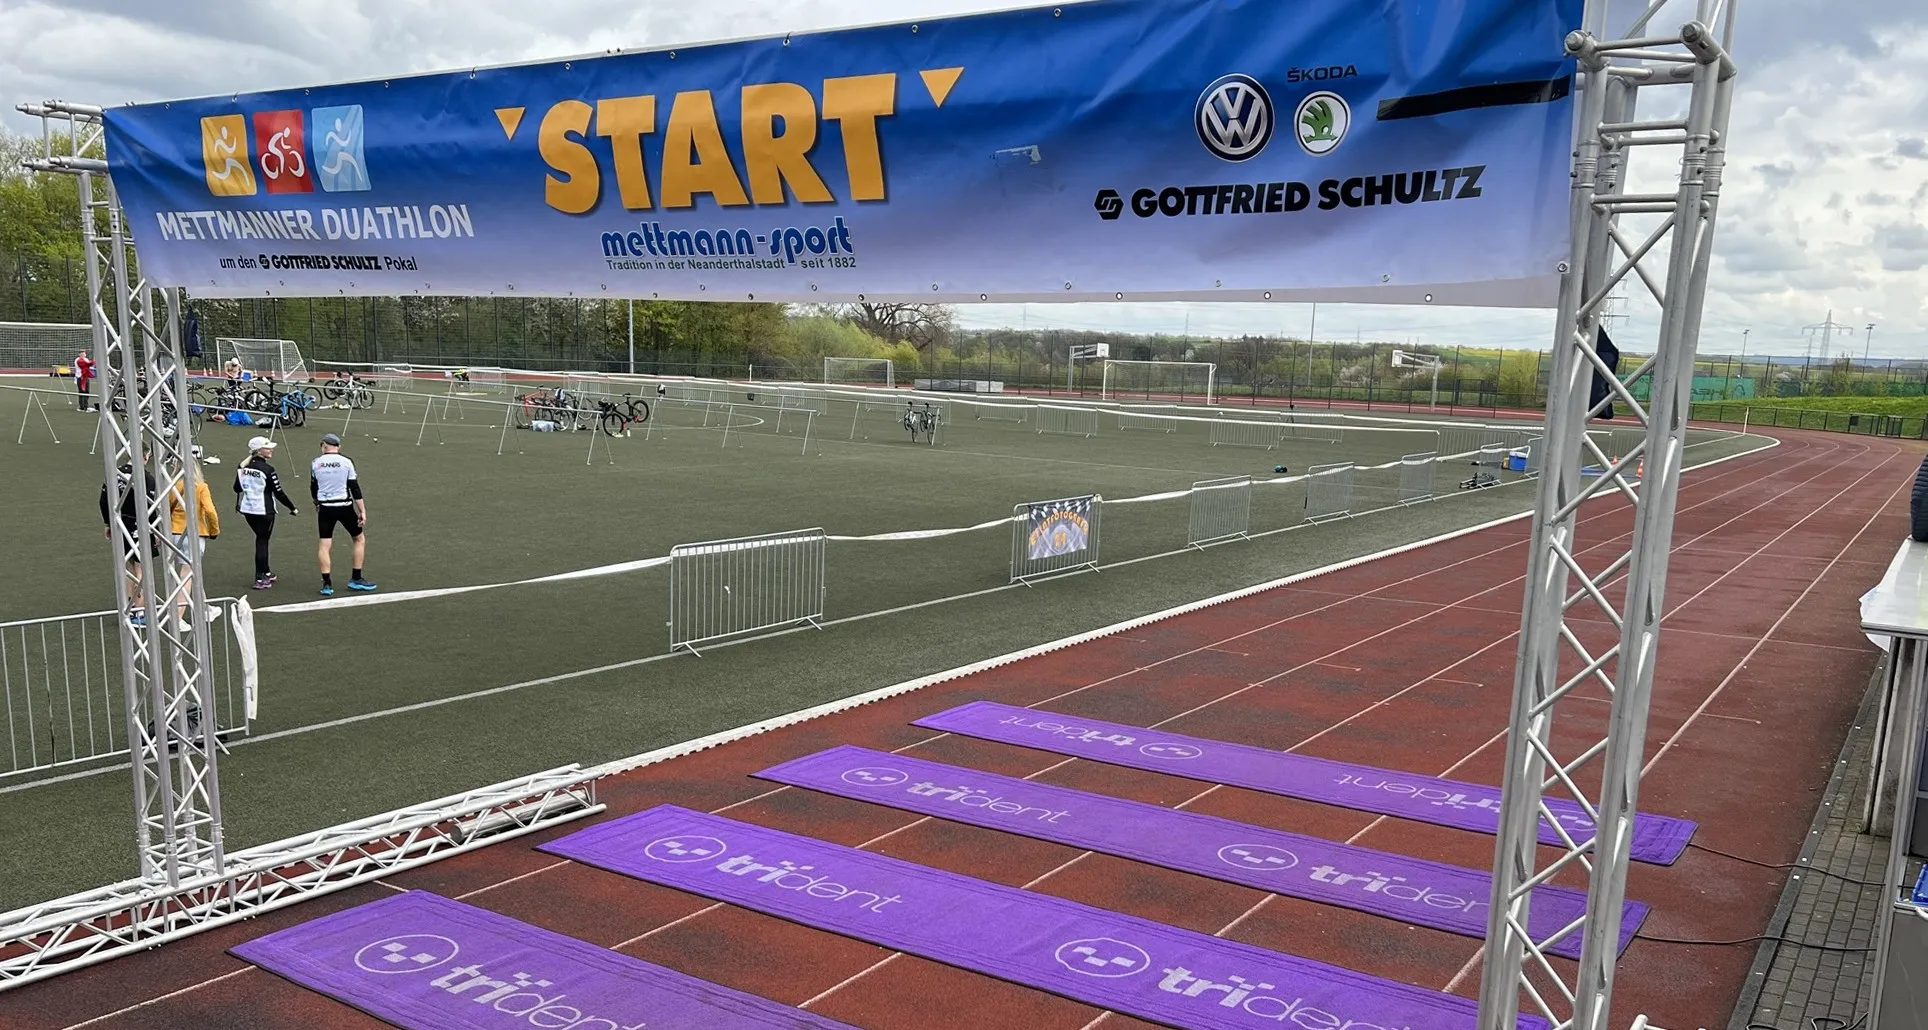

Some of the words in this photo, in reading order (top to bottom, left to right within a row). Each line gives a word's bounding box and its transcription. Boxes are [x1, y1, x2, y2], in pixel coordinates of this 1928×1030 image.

[1286, 64, 1358, 83] ŠKODA
[538, 73, 896, 214] START
[1131, 182, 1310, 218] GOTTFRIED
[1317, 165, 1487, 211] SCHULTZ
[156, 209, 322, 241] METTMANNER
[321, 204, 475, 240] DUATHLON
[601, 216, 855, 264] mettmann-sport
[219, 257, 237, 269] um
[238, 255, 257, 269] den
[271, 254, 331, 270] GOTTFRIED
[332, 255, 382, 270] SCHULTZ
[384, 256, 418, 271] Pokal
[606, 259, 652, 271] Tradition
[655, 259, 664, 270] in
[667, 259, 685, 270] der
[687, 258, 785, 270] Neanderthalstadt
[800, 257, 825, 269] seit
[828, 257, 857, 269] 1882
[1308, 865, 1490, 912] triden
